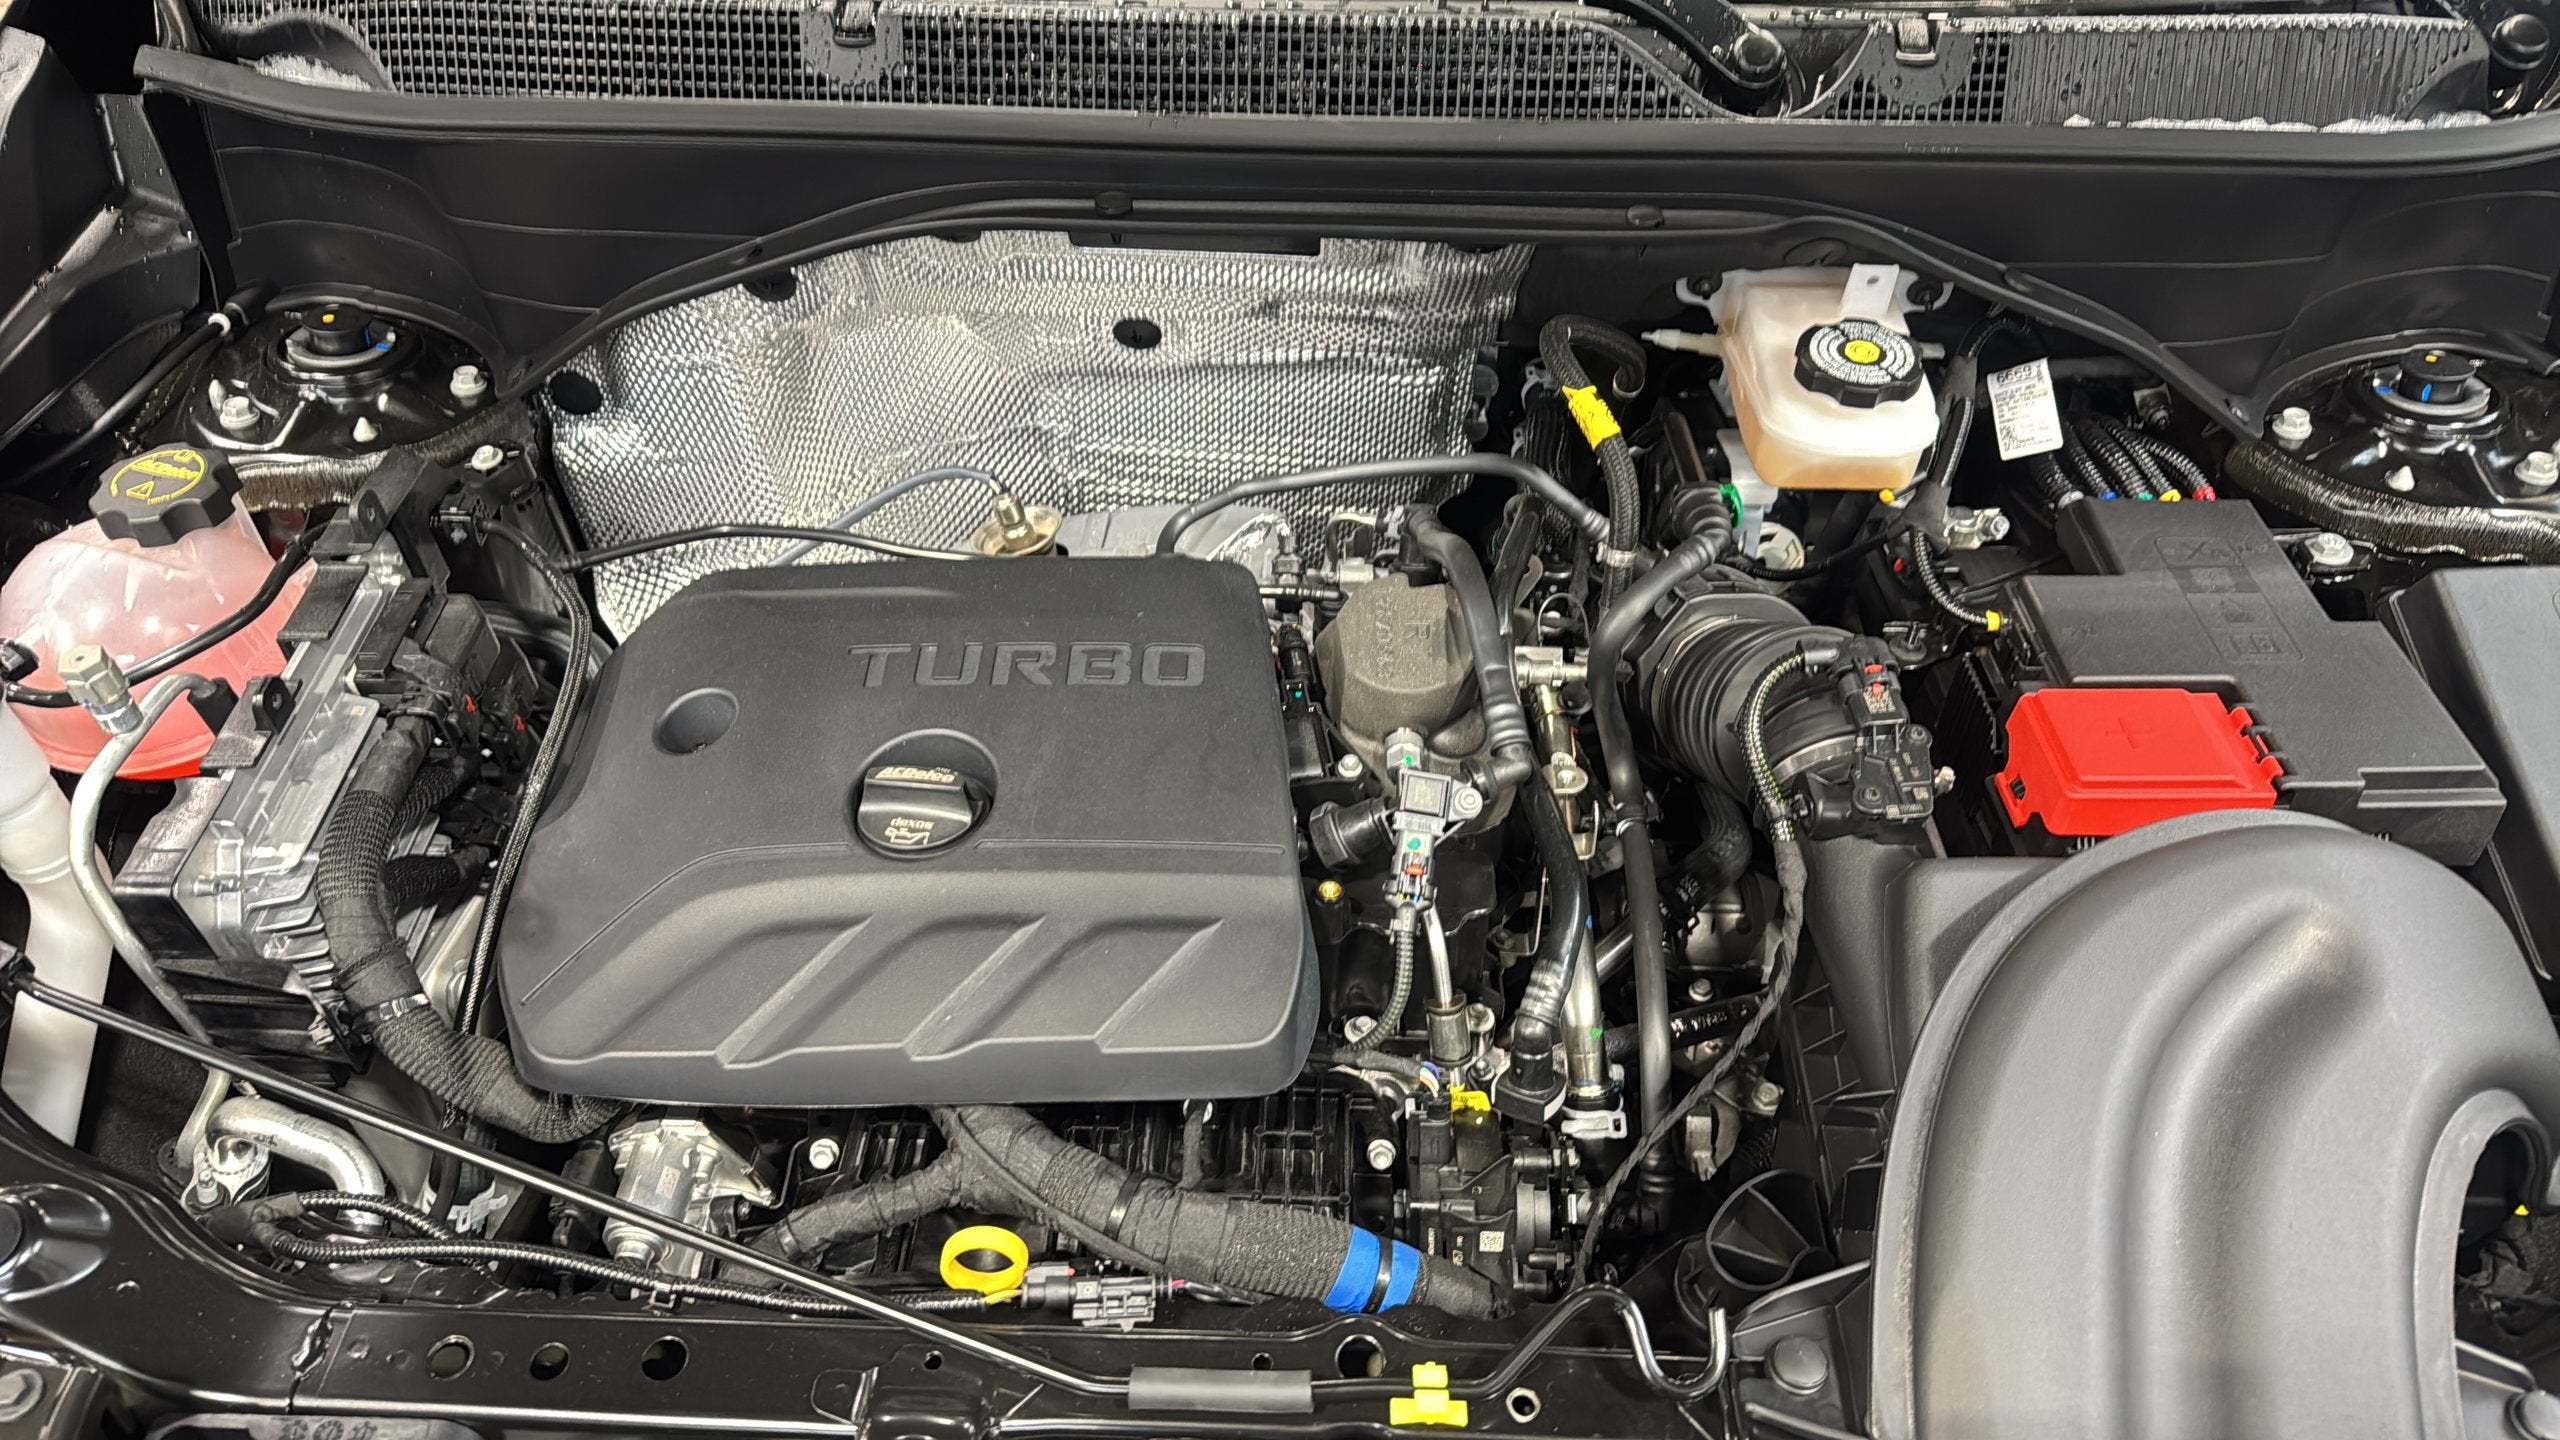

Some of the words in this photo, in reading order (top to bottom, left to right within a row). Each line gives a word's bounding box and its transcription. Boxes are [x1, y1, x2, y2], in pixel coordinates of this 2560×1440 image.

[1996, 364, 2032, 384] 6669
[848, 641, 1206, 687] TURBO
[875, 766, 955, 783] ACDelco
